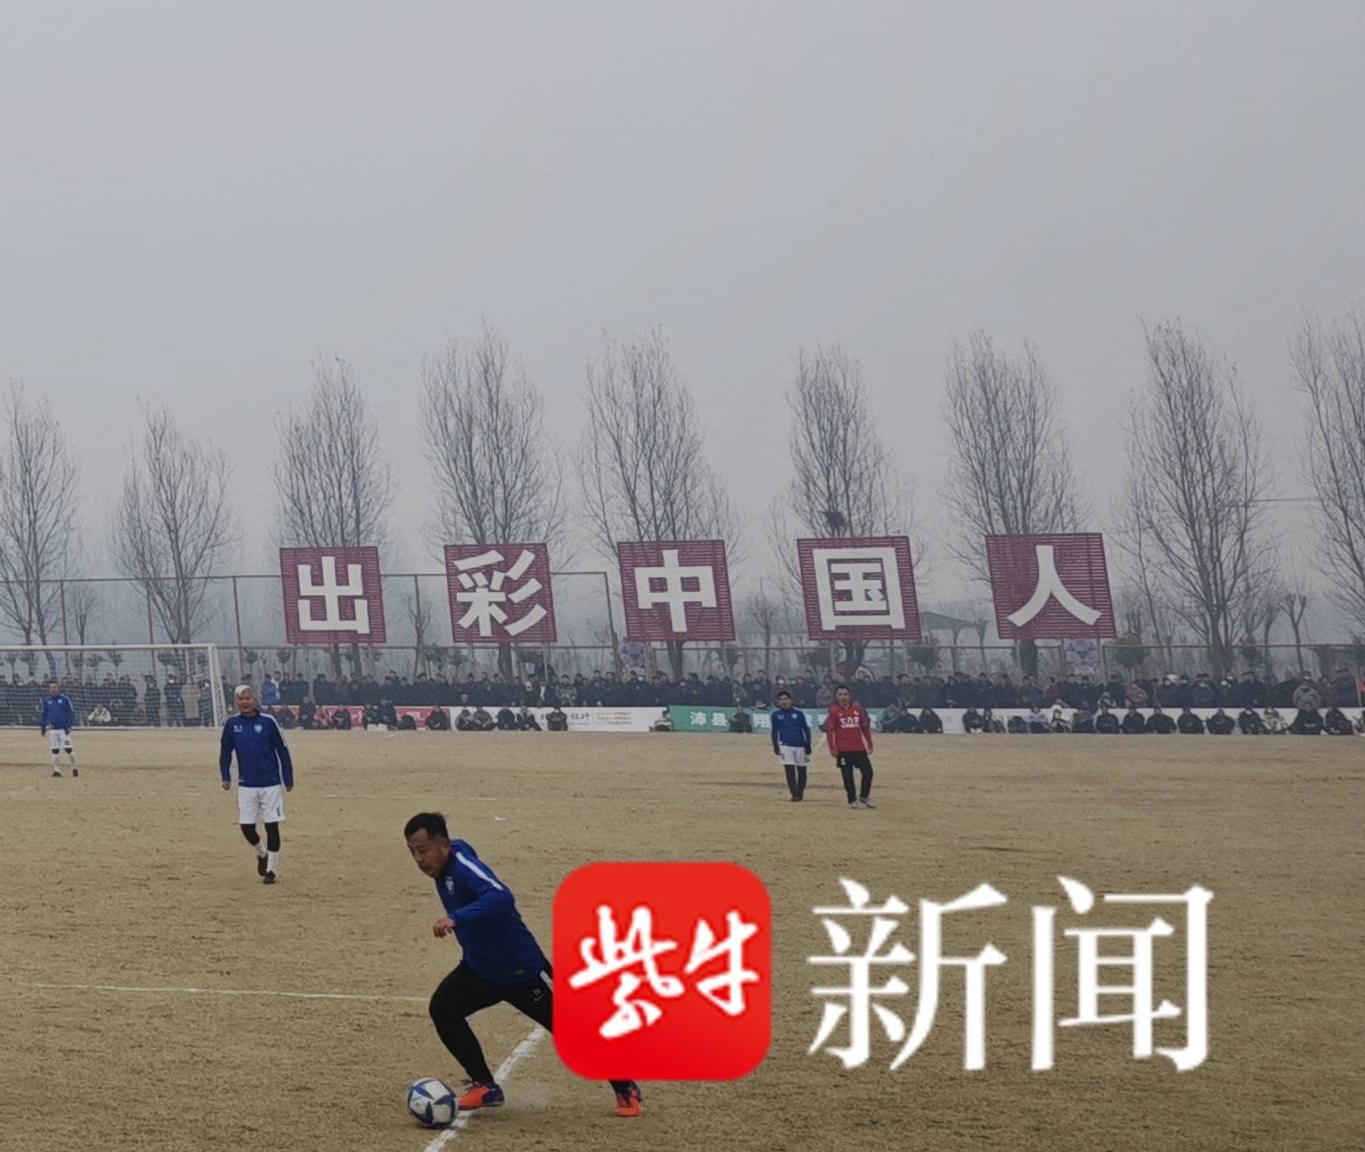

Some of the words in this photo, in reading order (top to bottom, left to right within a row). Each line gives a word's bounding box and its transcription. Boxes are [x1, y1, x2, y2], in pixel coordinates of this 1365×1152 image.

[296, 545, 1102, 638] 出彩中国人
